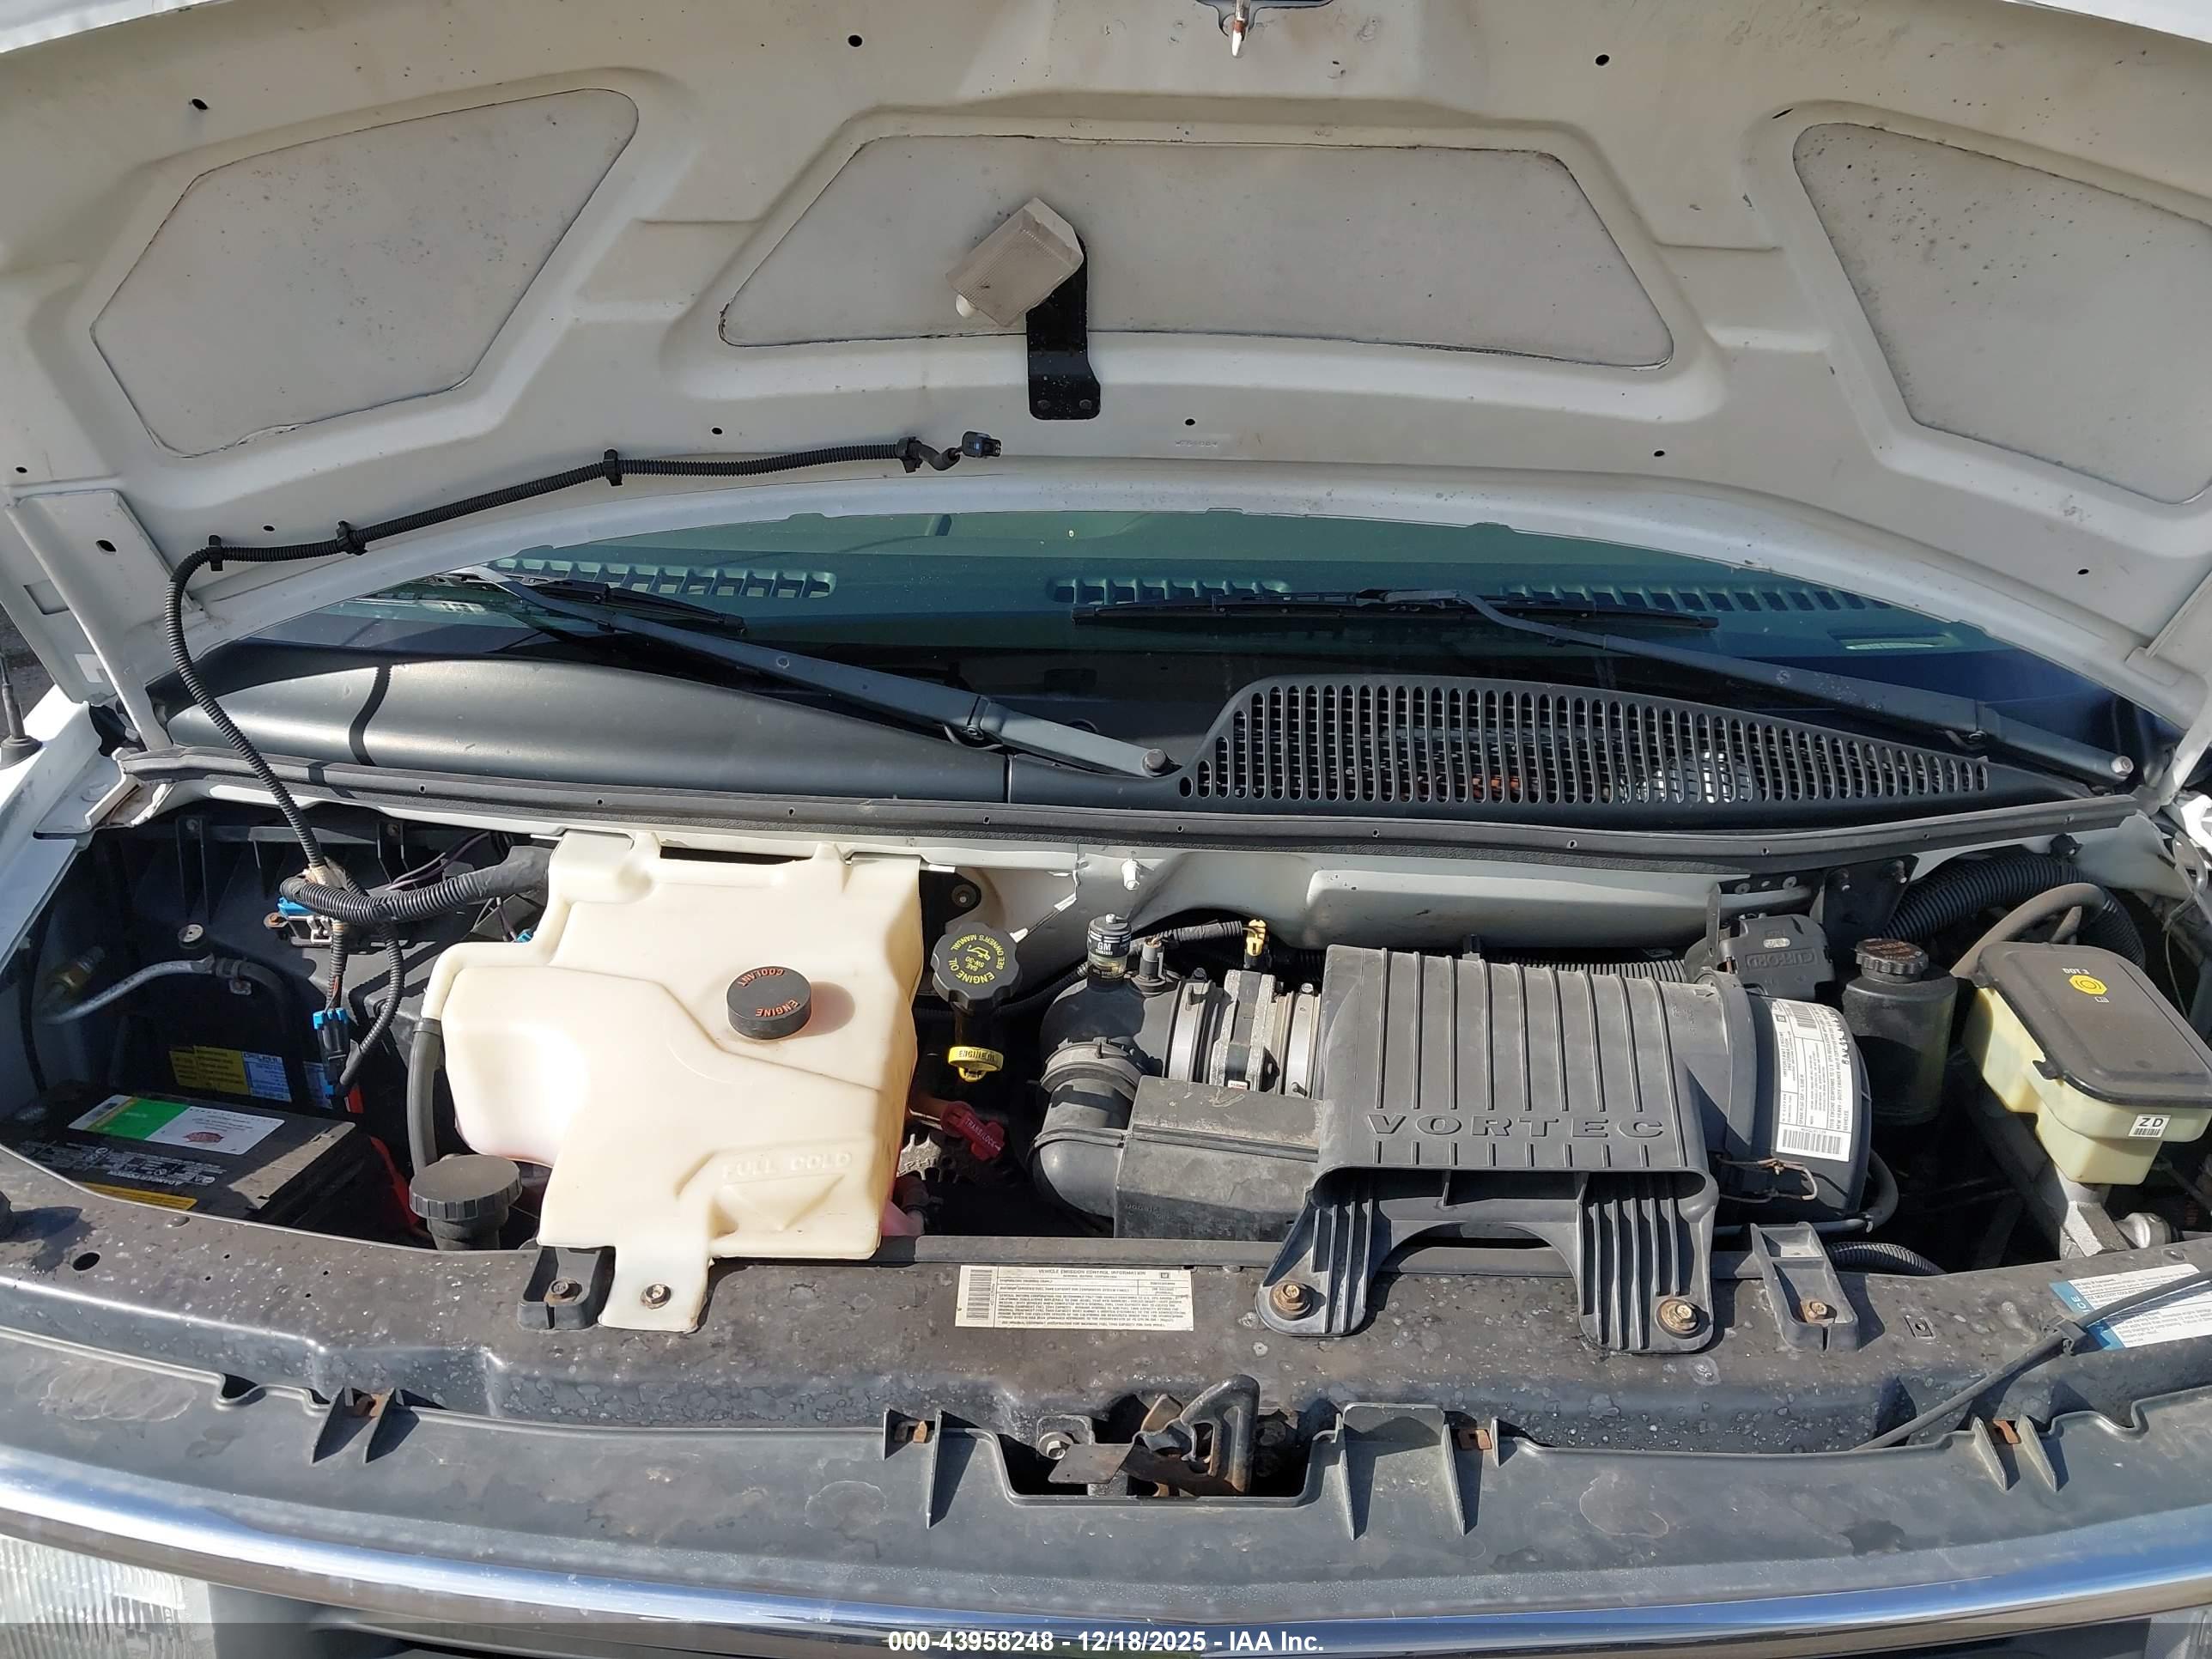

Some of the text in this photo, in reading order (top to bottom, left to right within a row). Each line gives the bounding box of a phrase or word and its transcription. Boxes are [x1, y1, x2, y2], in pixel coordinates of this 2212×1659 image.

[951, 933, 1005, 970] SEE OWNER'S MANUAL
[1097, 941, 1112, 951] GM
[948, 957, 995, 984] ENGINE OIL
[964, 956, 985, 968] 5W-30
[965, 963, 979, 972] SAE
[738, 969, 785, 987] COOLANT
[756, 1000, 799, 1018] ENGINE
[958, 1049, 987, 1059] ENGINE
[1367, 1114, 1664, 1139] VORTEC
[722, 1152, 853, 1180] FULL COLD
